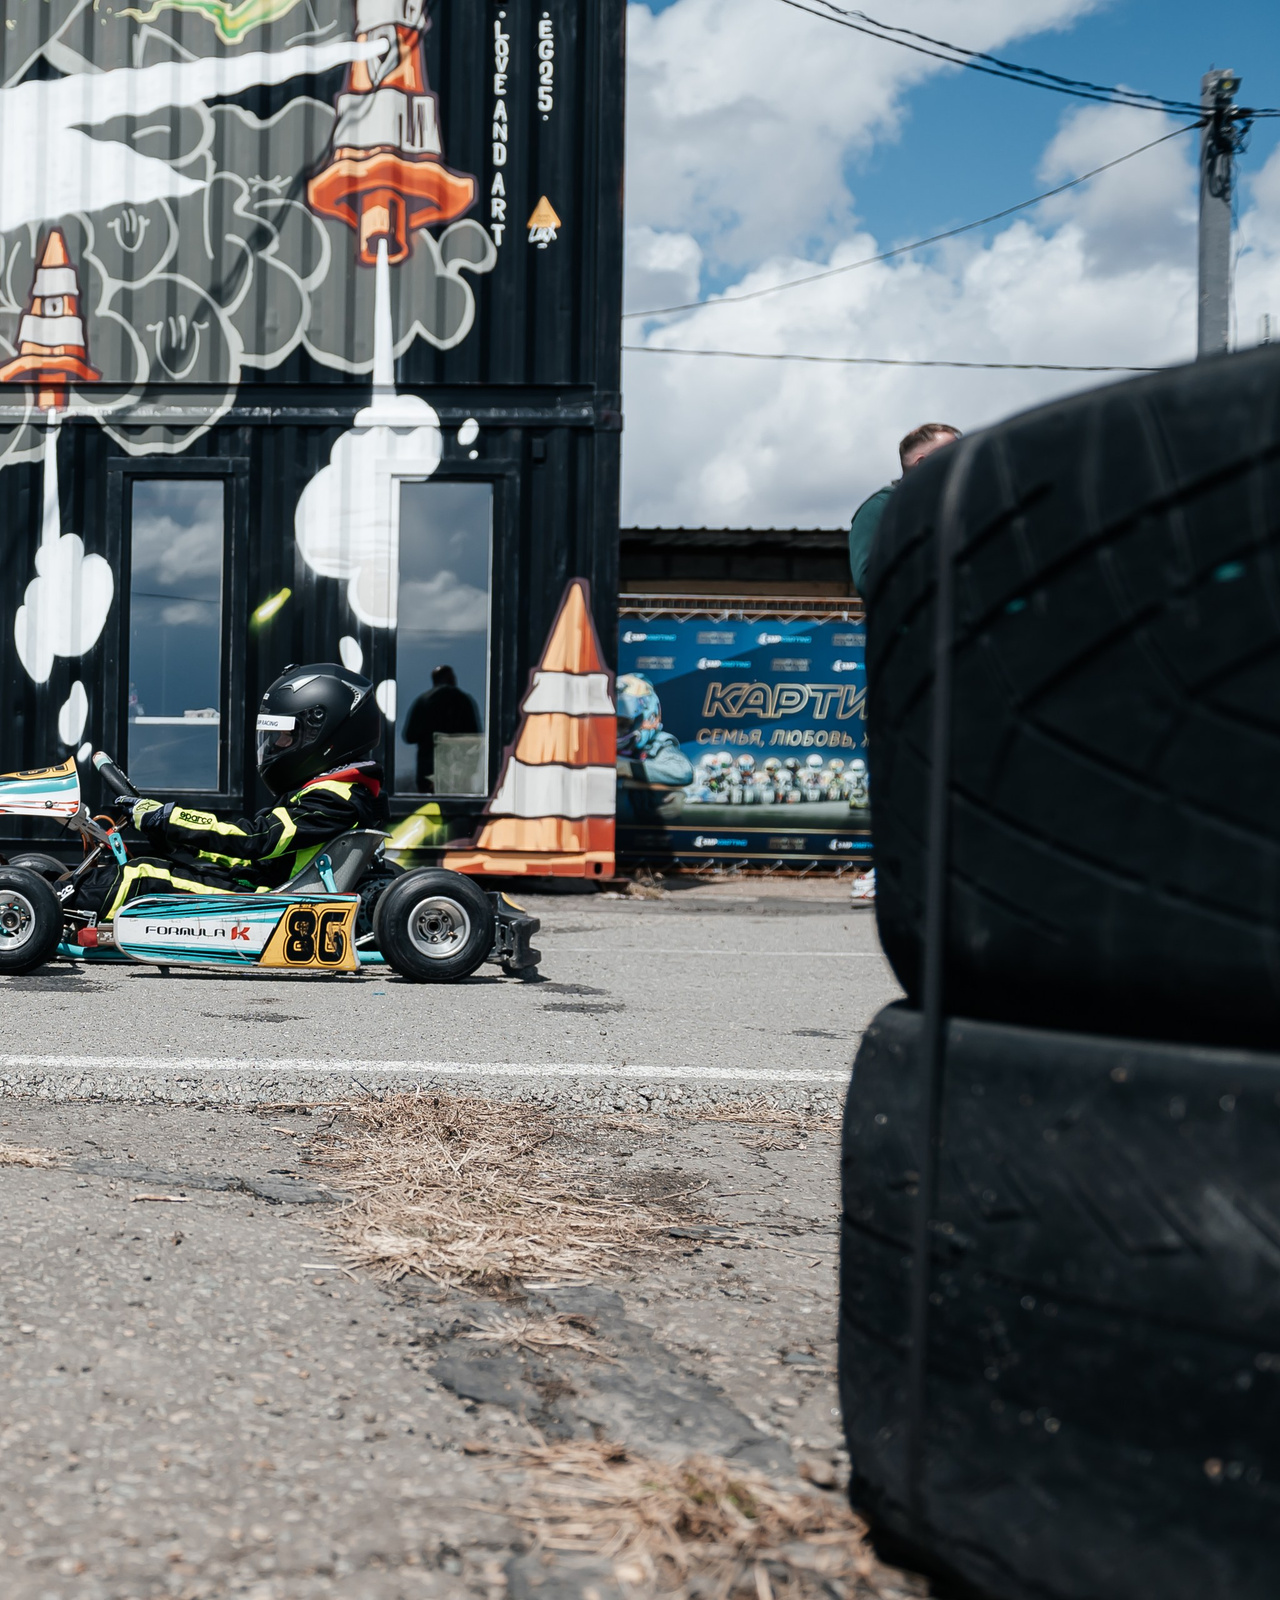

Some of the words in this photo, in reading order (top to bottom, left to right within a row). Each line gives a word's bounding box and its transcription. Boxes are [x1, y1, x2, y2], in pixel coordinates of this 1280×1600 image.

[492, 99, 508, 166] AND
[491, 172, 506, 247] ART
[696, 728, 765, 748] СЕМЬЯ,
[769, 729, 856, 749] ЛЮБОВЬ,
[145, 925, 226, 938] FORMULA
[231, 926, 251, 941] K
[283, 908, 351, 966] 86
